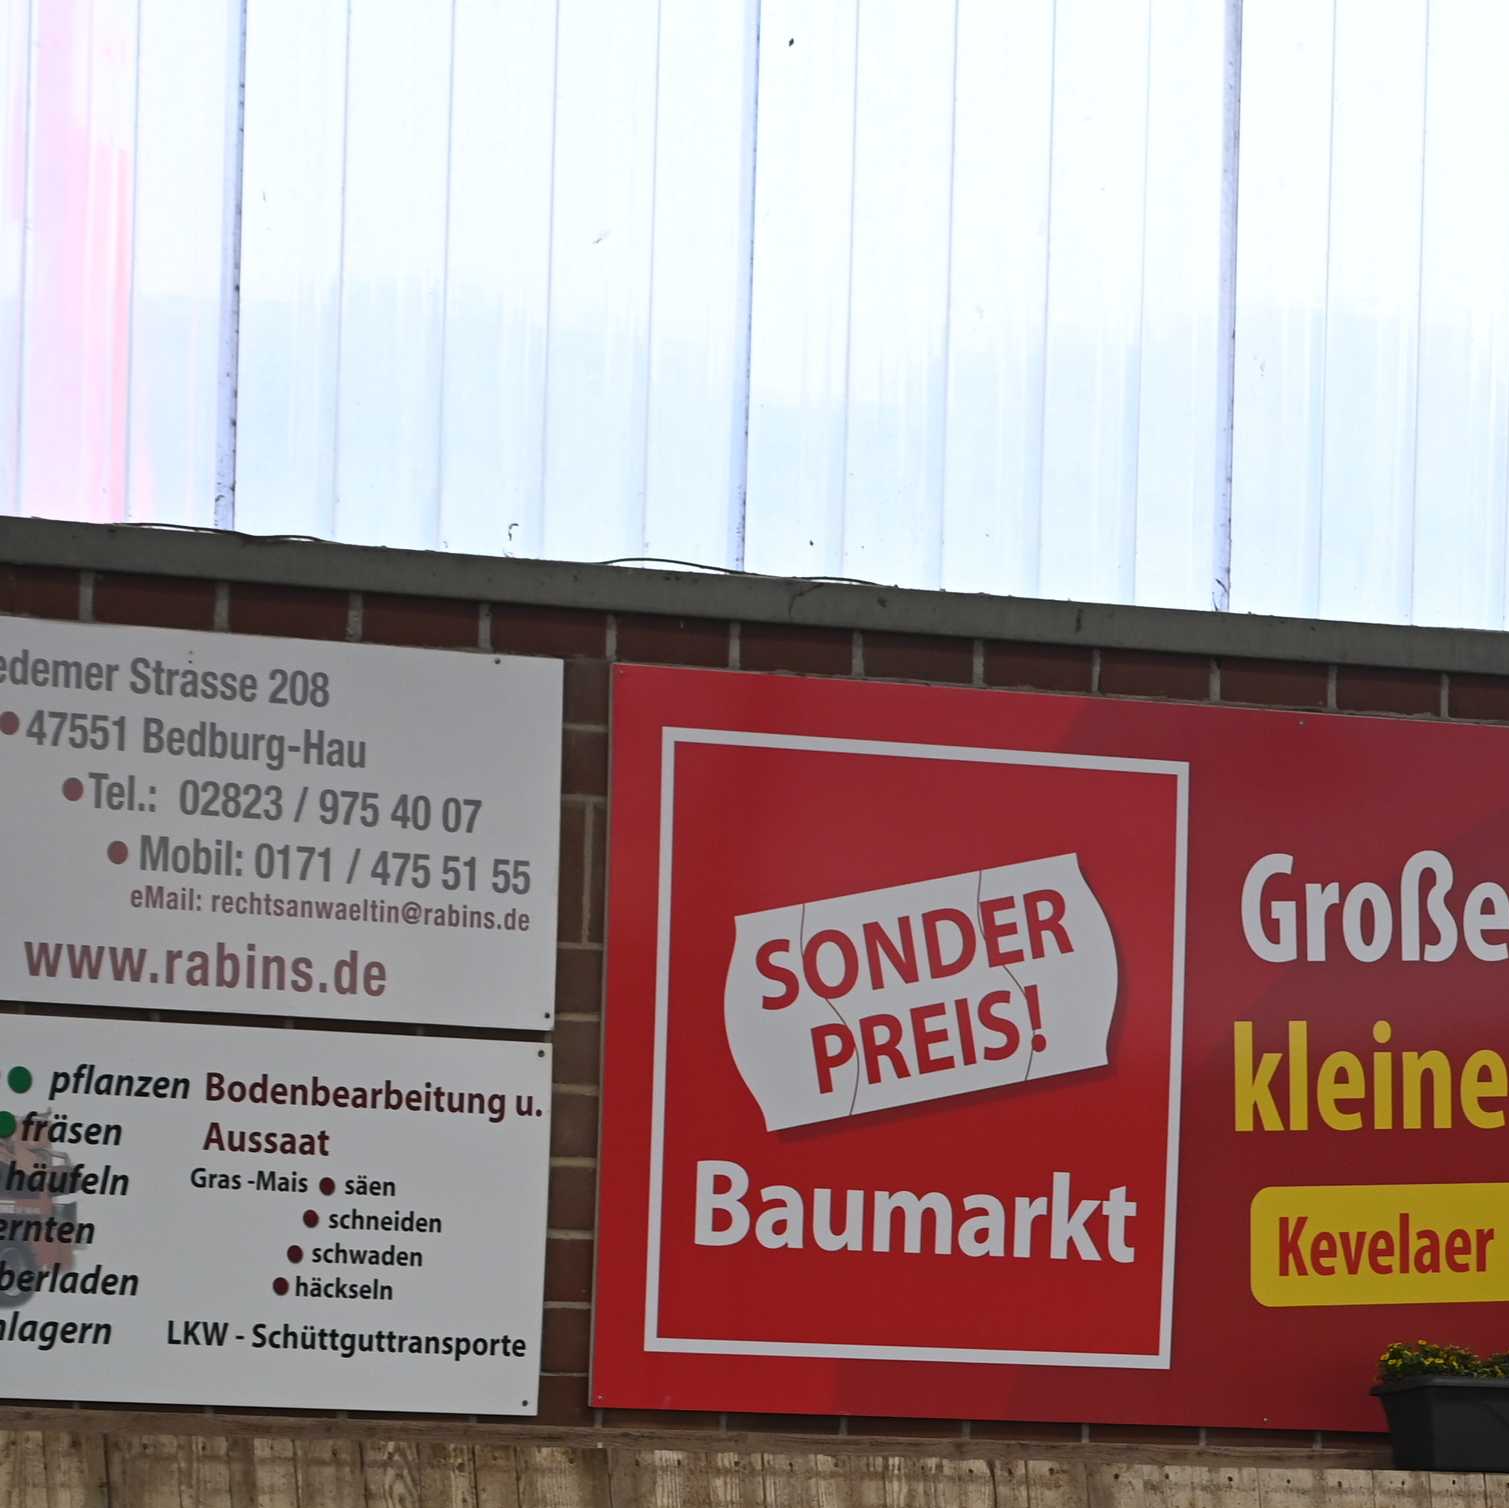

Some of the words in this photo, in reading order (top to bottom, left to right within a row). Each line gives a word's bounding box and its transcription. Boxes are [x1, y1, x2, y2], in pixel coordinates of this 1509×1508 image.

[130, 657, 257, 702] Strasse
[269, 669, 329, 707] 208
[26, 710, 125, 751] 47551
[144, 717, 366, 770] Bedburg-Hau
[88, 772, 156, 812] Tel.:
[180, 780, 282, 821] 02823
[294, 787, 309, 822] /
[320, 789, 379, 827] 975
[391, 794, 431, 830] 40
[442, 798, 482, 833] 07
[140, 835, 242, 876] Mobil:
[255, 843, 330, 882] 0171
[346, 848, 361, 884] /
[371, 851, 430, 888] 475
[442, 856, 476, 891] 51
[492, 859, 530, 894] 55
[131, 885, 201, 911] eMail:
[212, 892, 529, 931] rechtsanwaeltin@rabins.de
[24, 941, 386, 996] www.rabins.de
[755, 888, 1074, 1011] SONDER
[811, 985, 1046, 1096] PREIS!
[48, 1064, 190, 1100] pflanzen
[206, 1073, 505, 1123] Bodenbearbeitung
[516, 1096, 542, 1117] u.
[1234, 1021, 1507, 1131] kleine
[20, 1111, 121, 1145] fräsen
[203, 1122, 329, 1156] Aussaat
[6, 1161, 129, 1197] häufeln
[191, 1168, 241, 1189] Gras
[345, 1180, 395, 1196] säen
[329, 1209, 441, 1233] schneiden
[695, 1160, 1136, 1263] Baumarkt
[312, 1243, 422, 1266] schwaden
[1279, 1213, 1494, 1276] Kevelaer
[296, 1276, 392, 1300] häckseln
[168, 1320, 228, 1346] LKW
[252, 1324, 526, 1361] Schüttguttransporte
